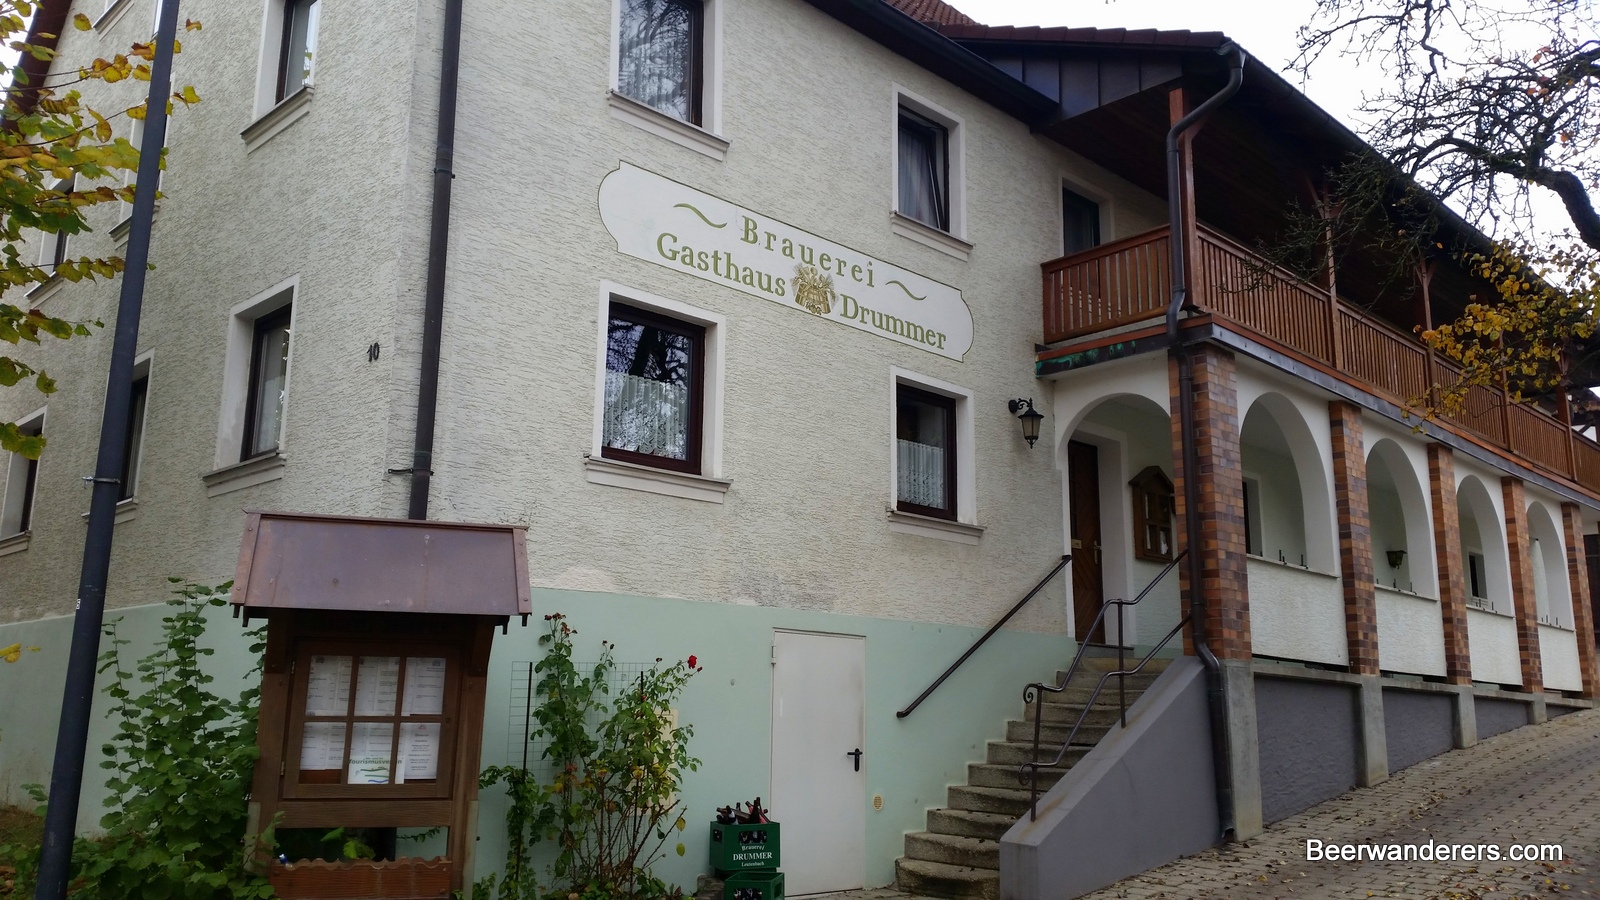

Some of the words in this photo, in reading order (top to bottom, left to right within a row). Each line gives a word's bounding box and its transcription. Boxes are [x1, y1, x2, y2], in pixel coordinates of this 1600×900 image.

[740, 215, 876, 288] Brauerei
[656, 232, 787, 297] Gasthaus
[839, 293, 947, 350] Drummer
[366, 342, 380, 362] 10
[732, 852, 773, 861] DRUMMER
